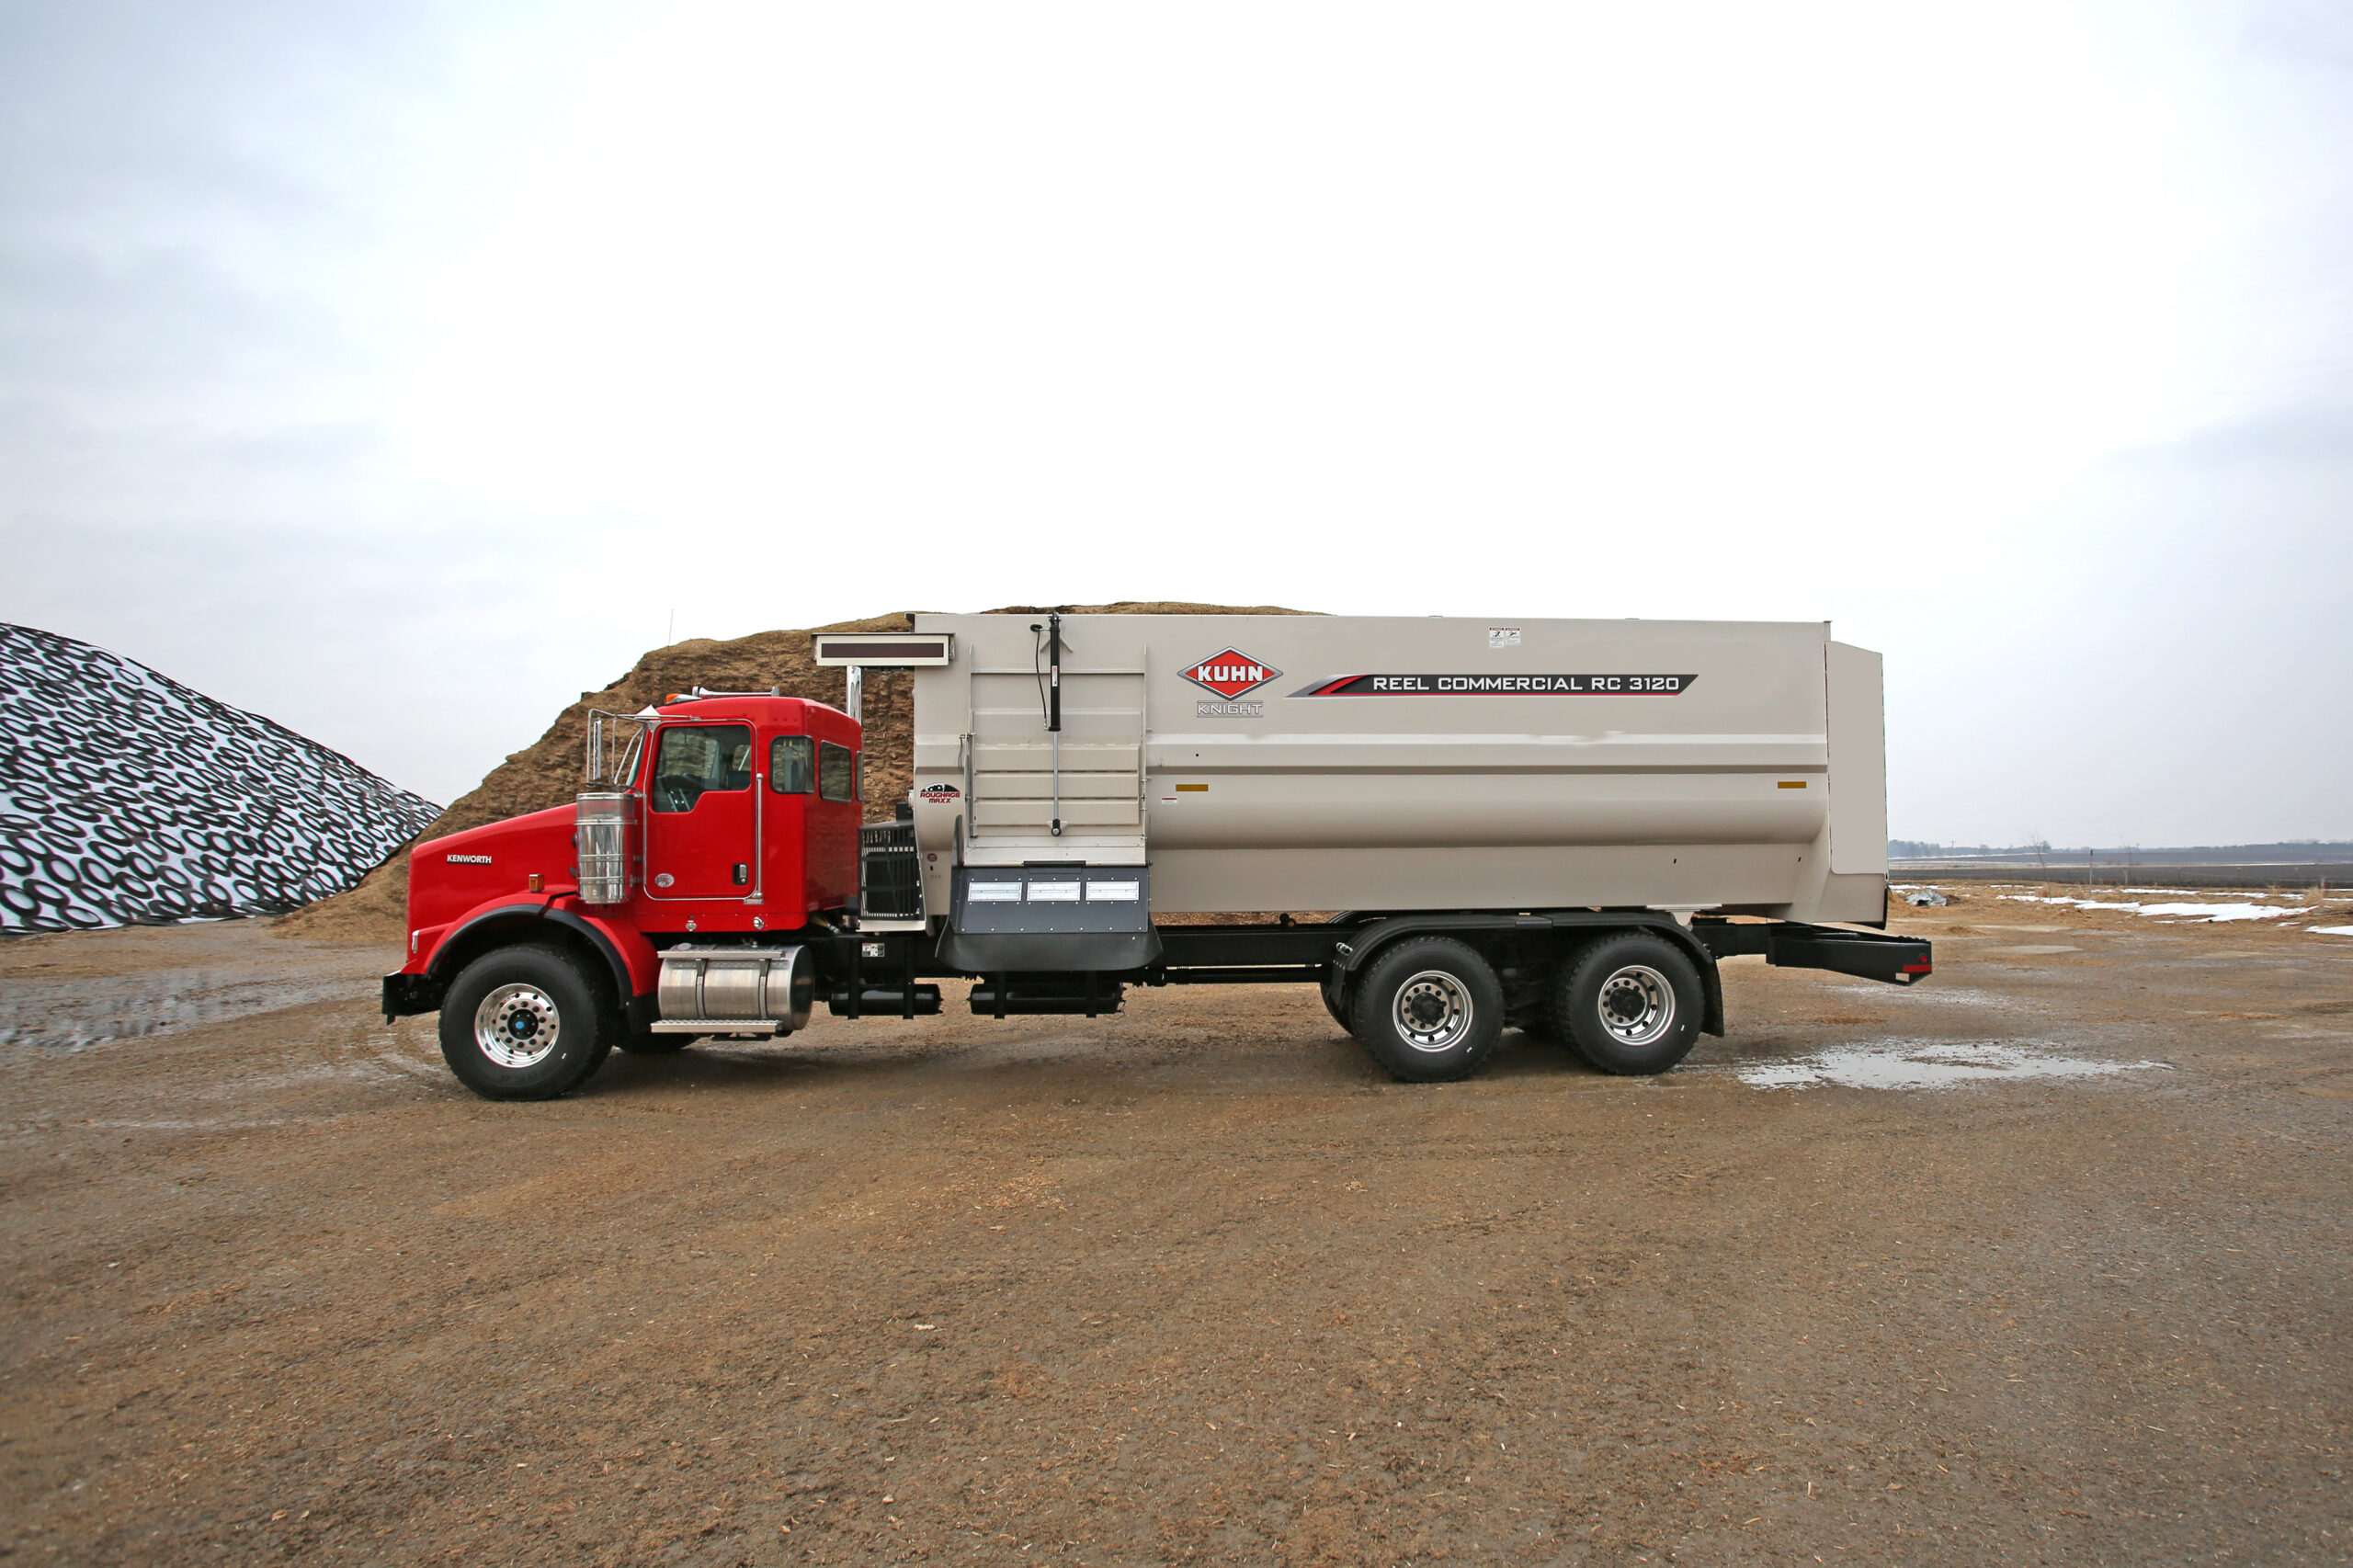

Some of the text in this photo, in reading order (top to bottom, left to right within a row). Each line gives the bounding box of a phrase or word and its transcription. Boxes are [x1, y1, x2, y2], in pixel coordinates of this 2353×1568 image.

[1198, 665, 1263, 682] KUHN
[1373, 677, 1679, 690] REEL COMMERCIAL RC 3120
[1198, 704, 1263, 714] KNIGHT
[447, 854, 492, 864] KENWORTH
